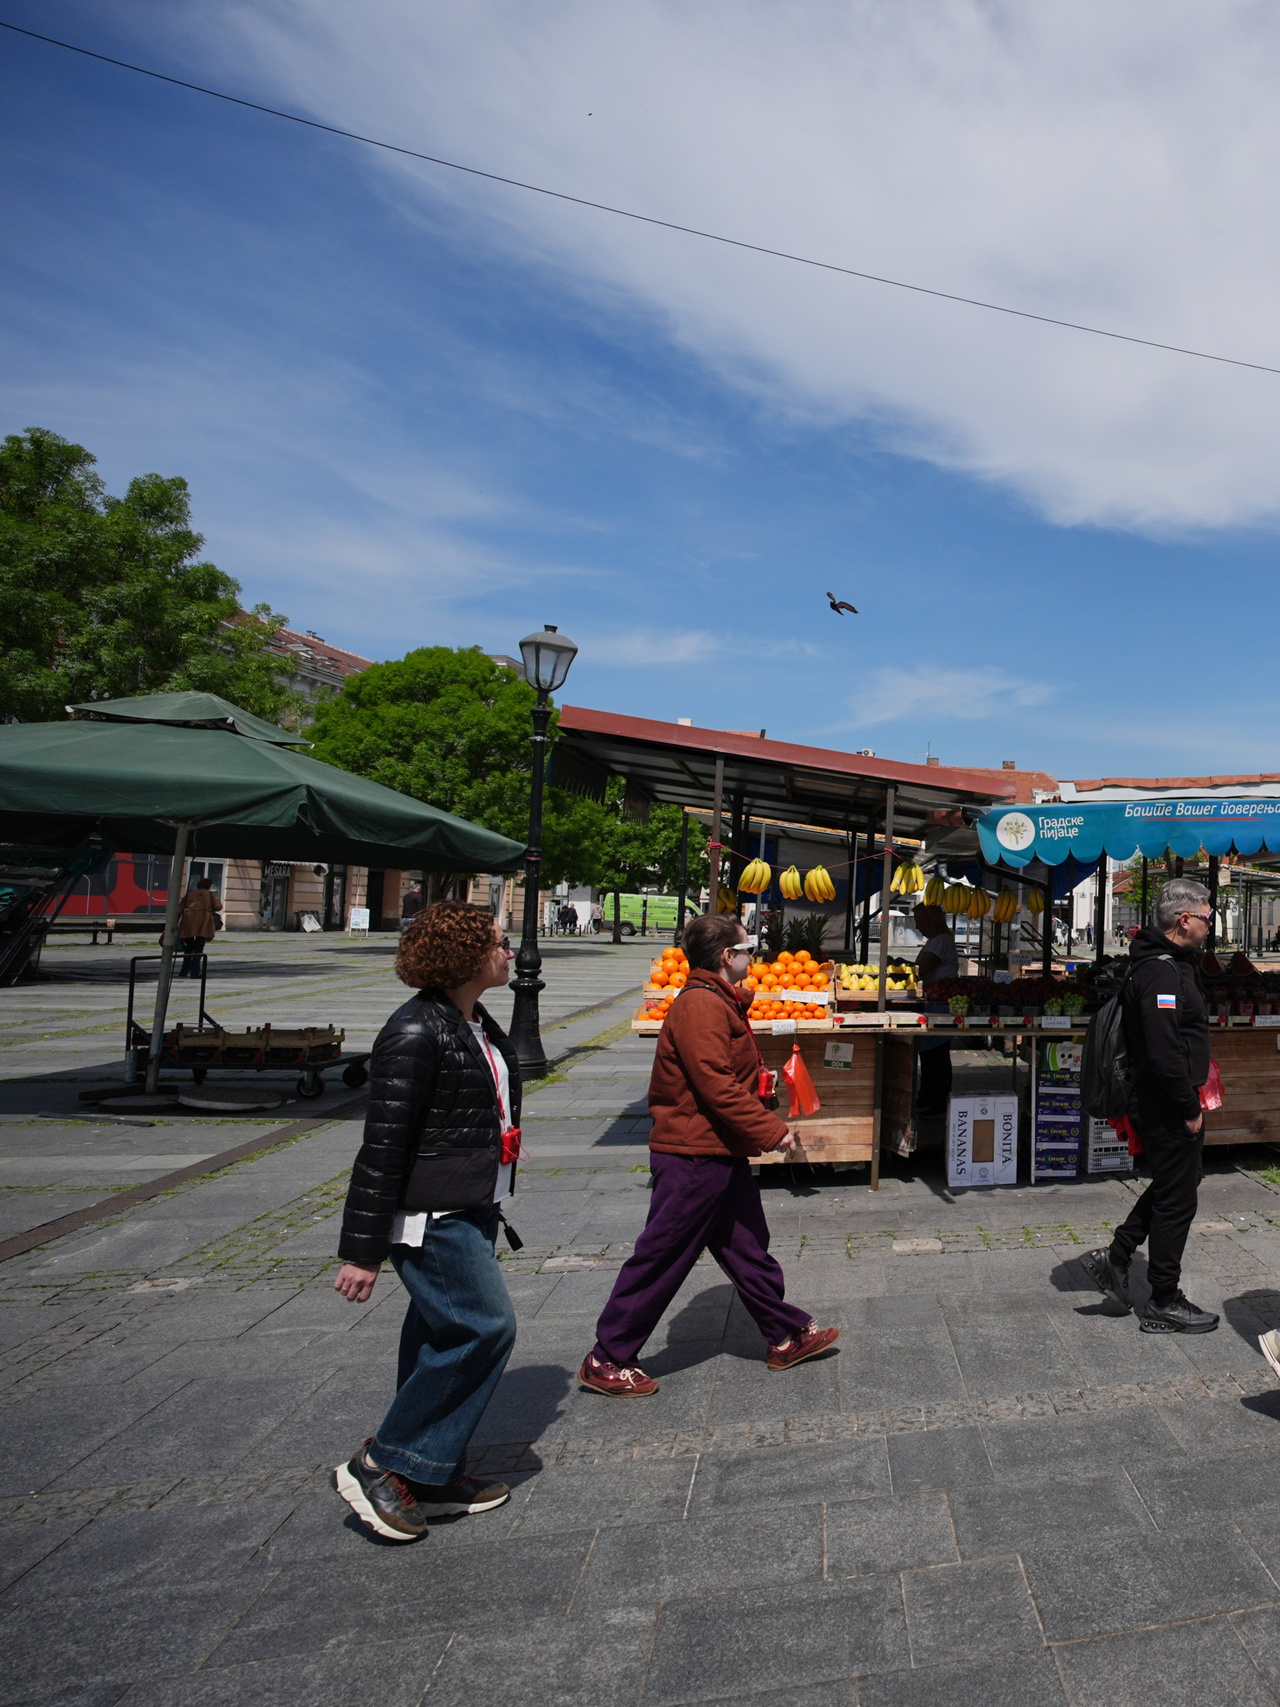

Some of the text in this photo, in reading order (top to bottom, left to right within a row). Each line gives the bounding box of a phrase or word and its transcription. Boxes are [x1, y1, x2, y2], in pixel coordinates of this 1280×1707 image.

[1175, 802, 1216, 816] Вашег
[1038, 815, 1084, 830] Градске
[1040, 827, 1079, 840] пијаце
[264, 865, 291, 878] MESARA
[956, 1110, 968, 1175] BANANAS
[1002, 1113, 1013, 1164] BONITA
